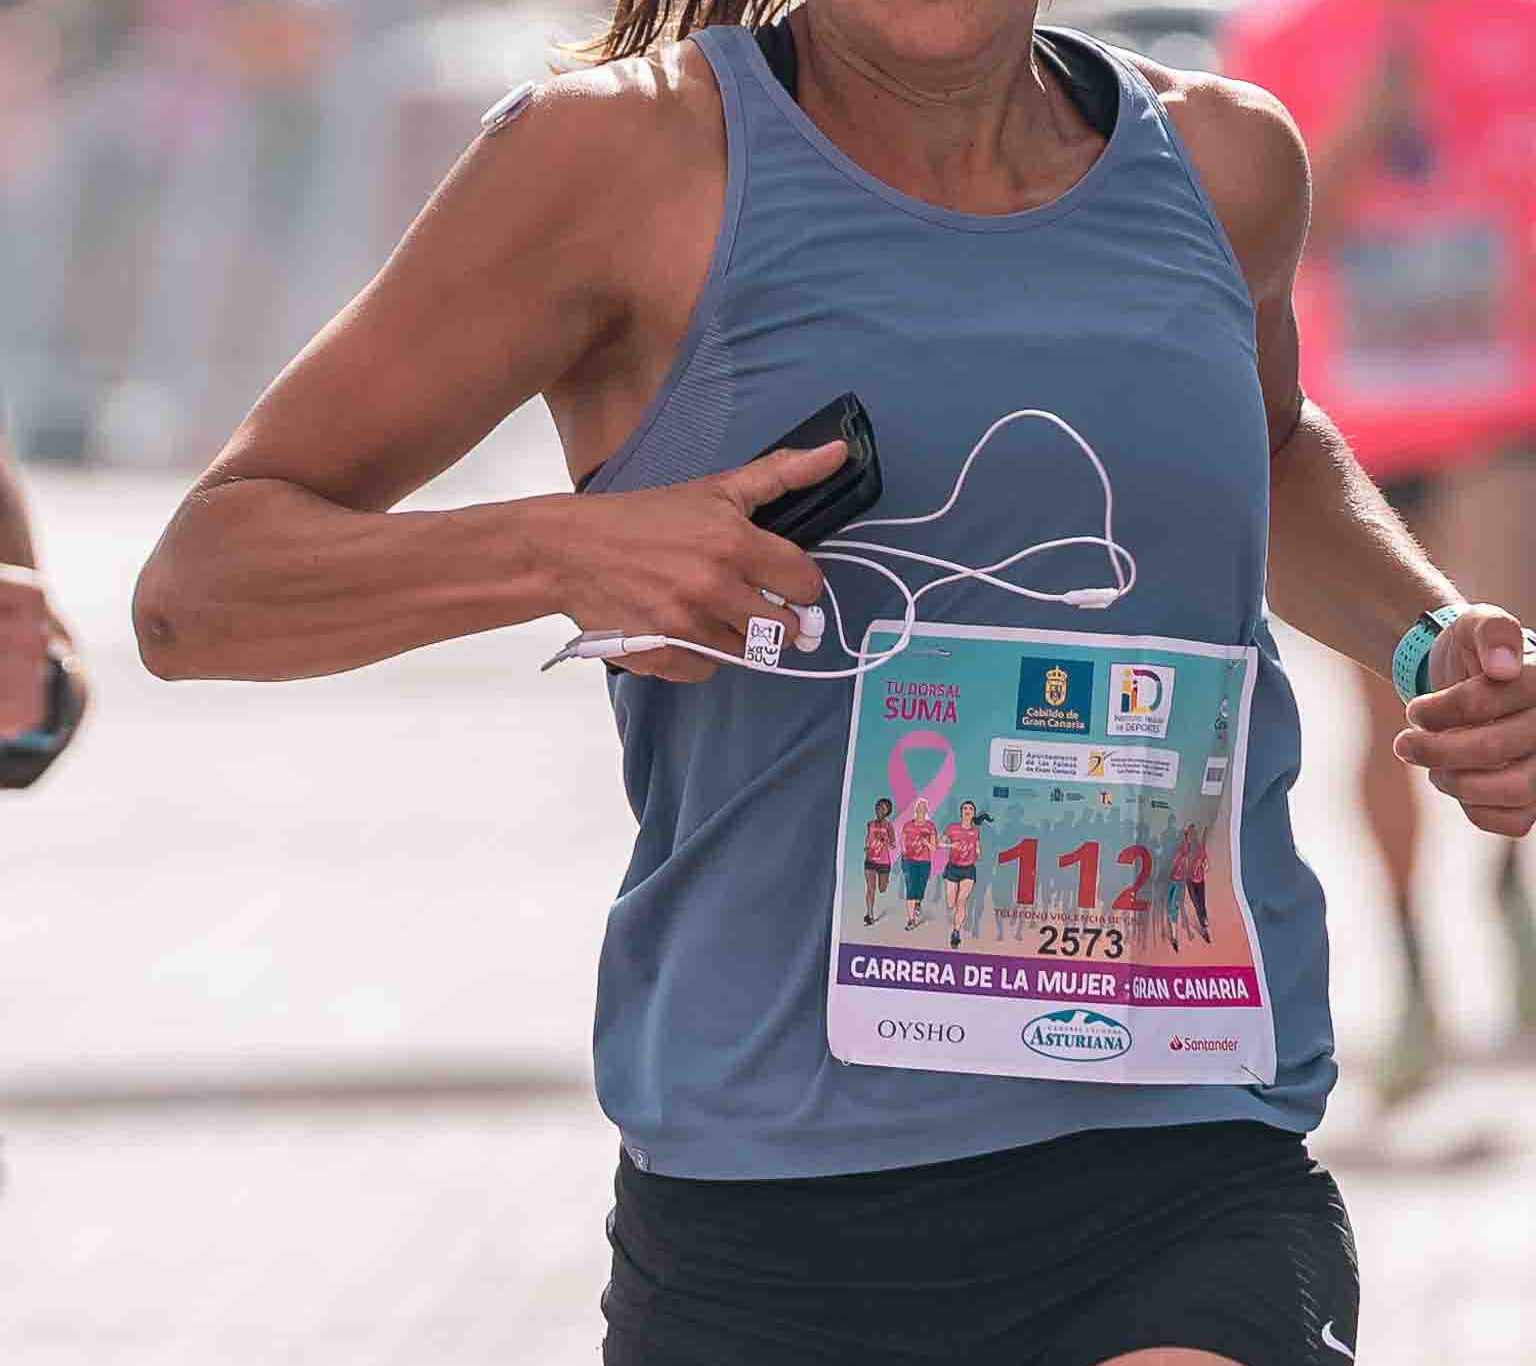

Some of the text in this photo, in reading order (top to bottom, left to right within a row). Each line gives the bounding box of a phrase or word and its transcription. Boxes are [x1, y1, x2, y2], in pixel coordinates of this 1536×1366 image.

[884, 697, 957, 723] SUMA
[1026, 707, 1064, 719] Cabildo
[1023, 717, 1085, 730] Gran Canaria
[998, 838, 1153, 911] 112
[1038, 925, 1123, 959] 2573
[851, 956, 1249, 1000] CARRERA DE LA MUJER GRAN CANARIA
[878, 1019, 965, 1043] OYSHO
[1030, 1025, 1124, 1050] ASTURIANA
[1184, 1035, 1238, 1051] Santander
